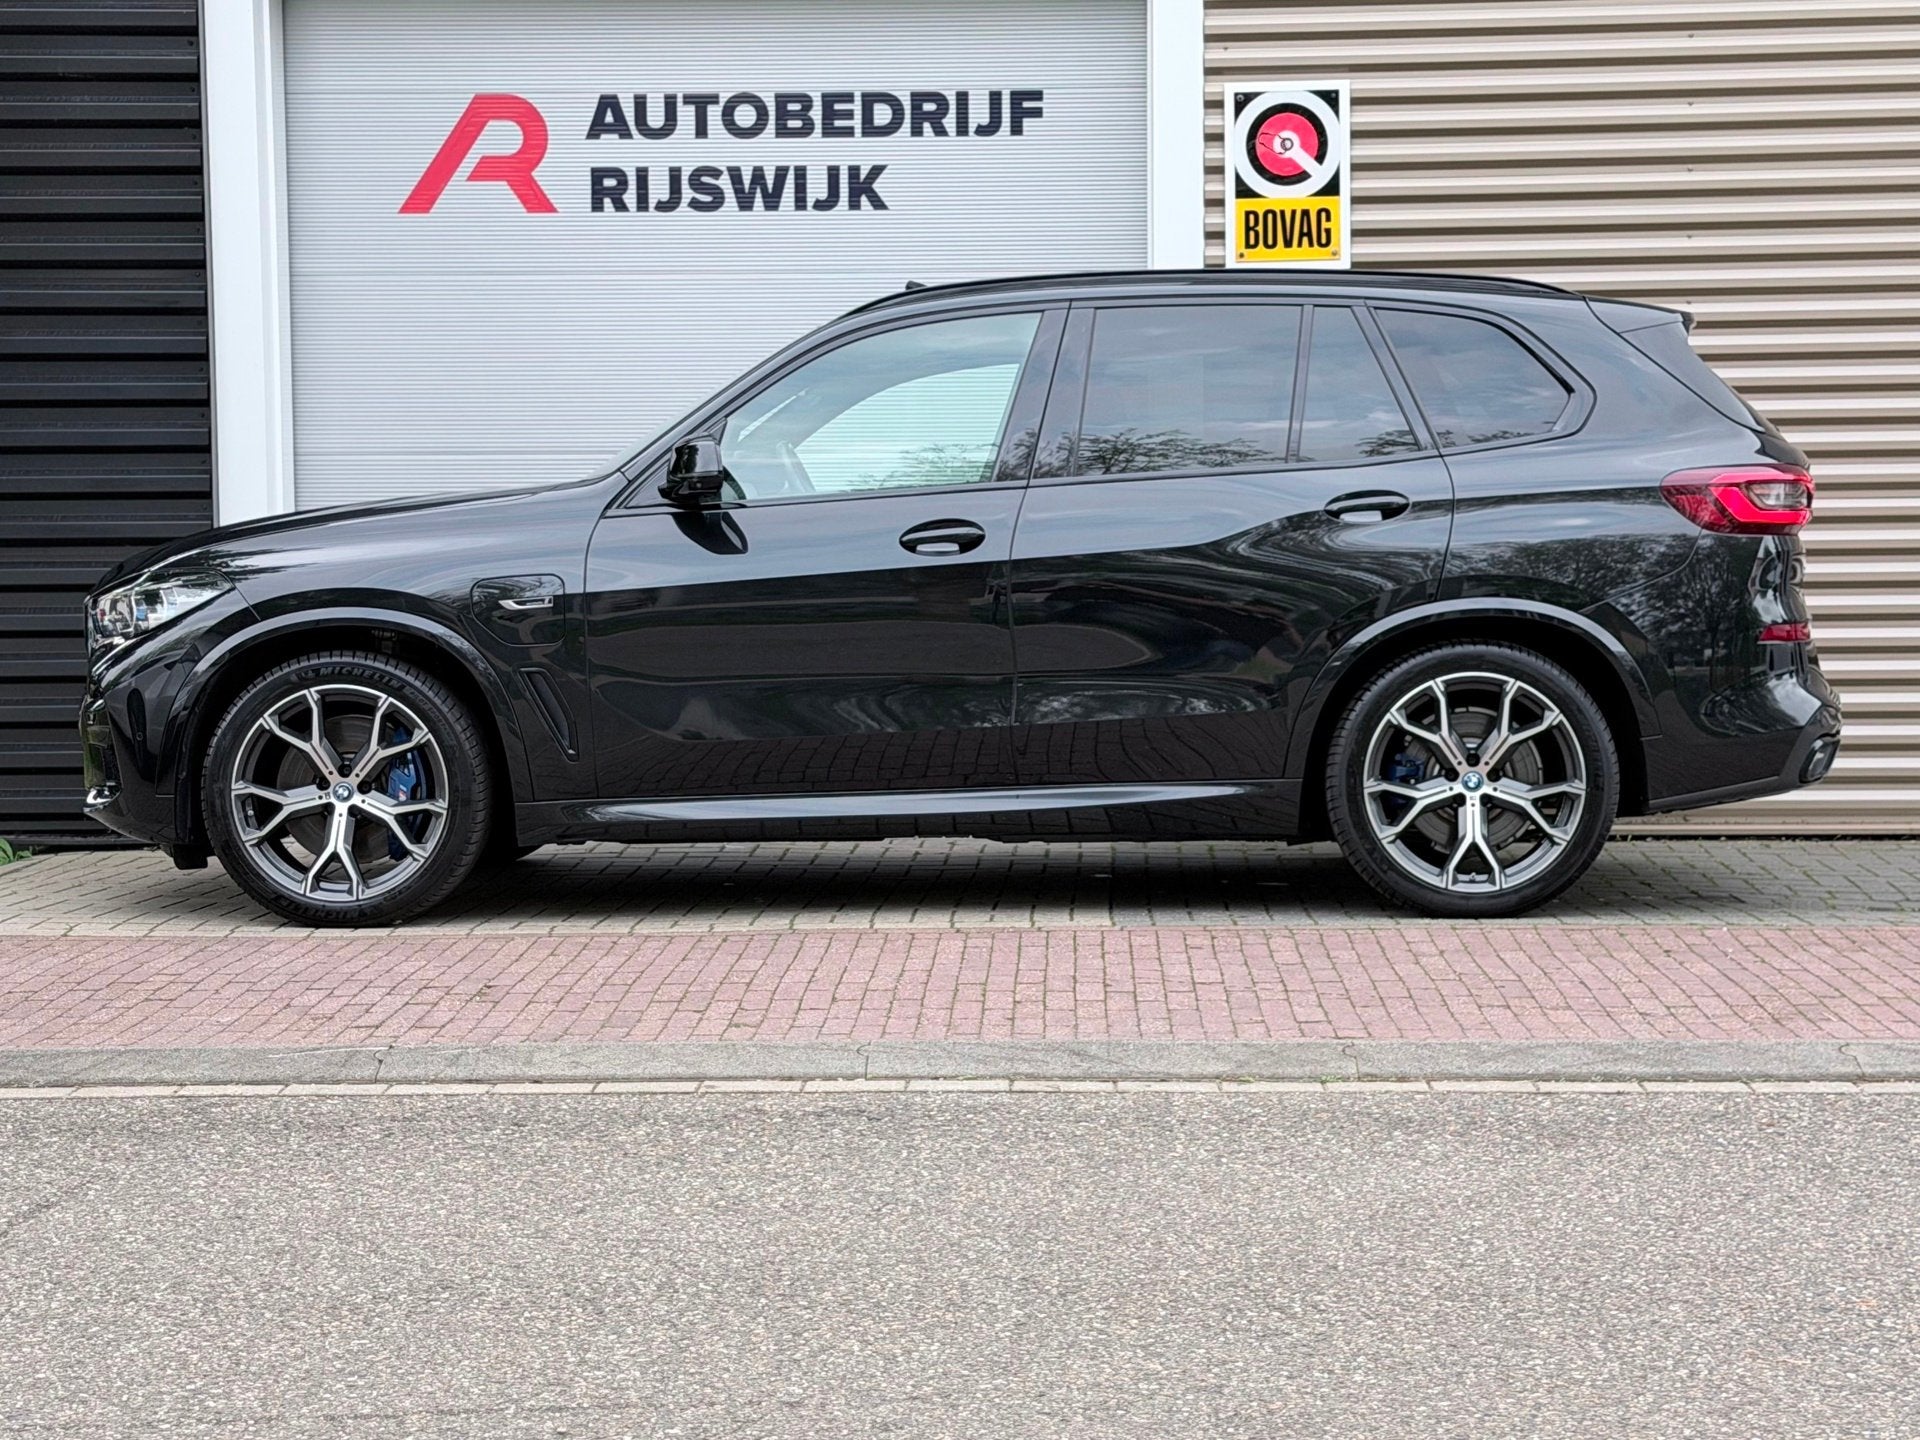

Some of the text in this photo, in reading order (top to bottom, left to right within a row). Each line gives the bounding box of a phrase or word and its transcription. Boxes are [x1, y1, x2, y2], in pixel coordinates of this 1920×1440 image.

[585, 90, 1044, 141] AUTOBEDRIJF
[590, 164, 889, 212] RIJSWIJK
[1244, 207, 1332, 250] BOVAG
[320, 666, 403, 689] MICHELIN
